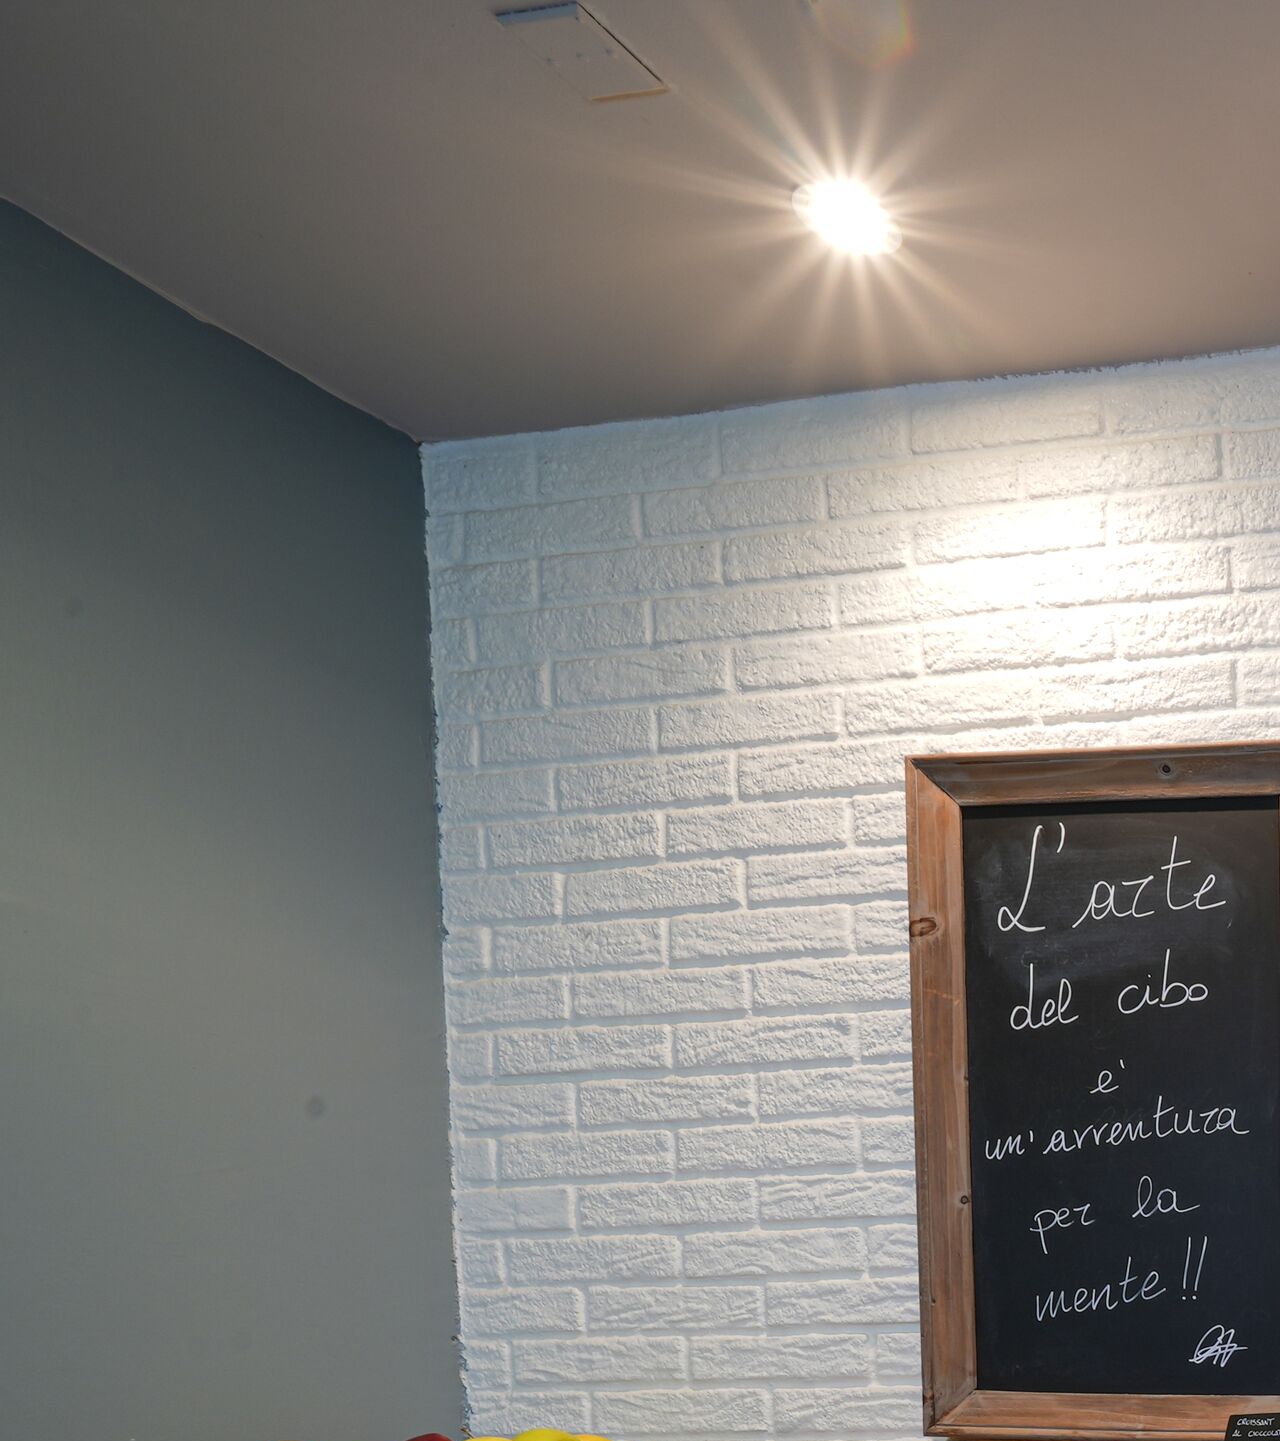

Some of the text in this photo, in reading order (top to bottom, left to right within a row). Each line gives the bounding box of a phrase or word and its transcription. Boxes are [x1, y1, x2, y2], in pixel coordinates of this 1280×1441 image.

[1010, 949, 1208, 1030] del cibo
[1030, 1175, 1200, 1254] per la
[1232, 1429, 1242, 1437] AL
[1237, 1418, 1275, 1426] CROISSANT
